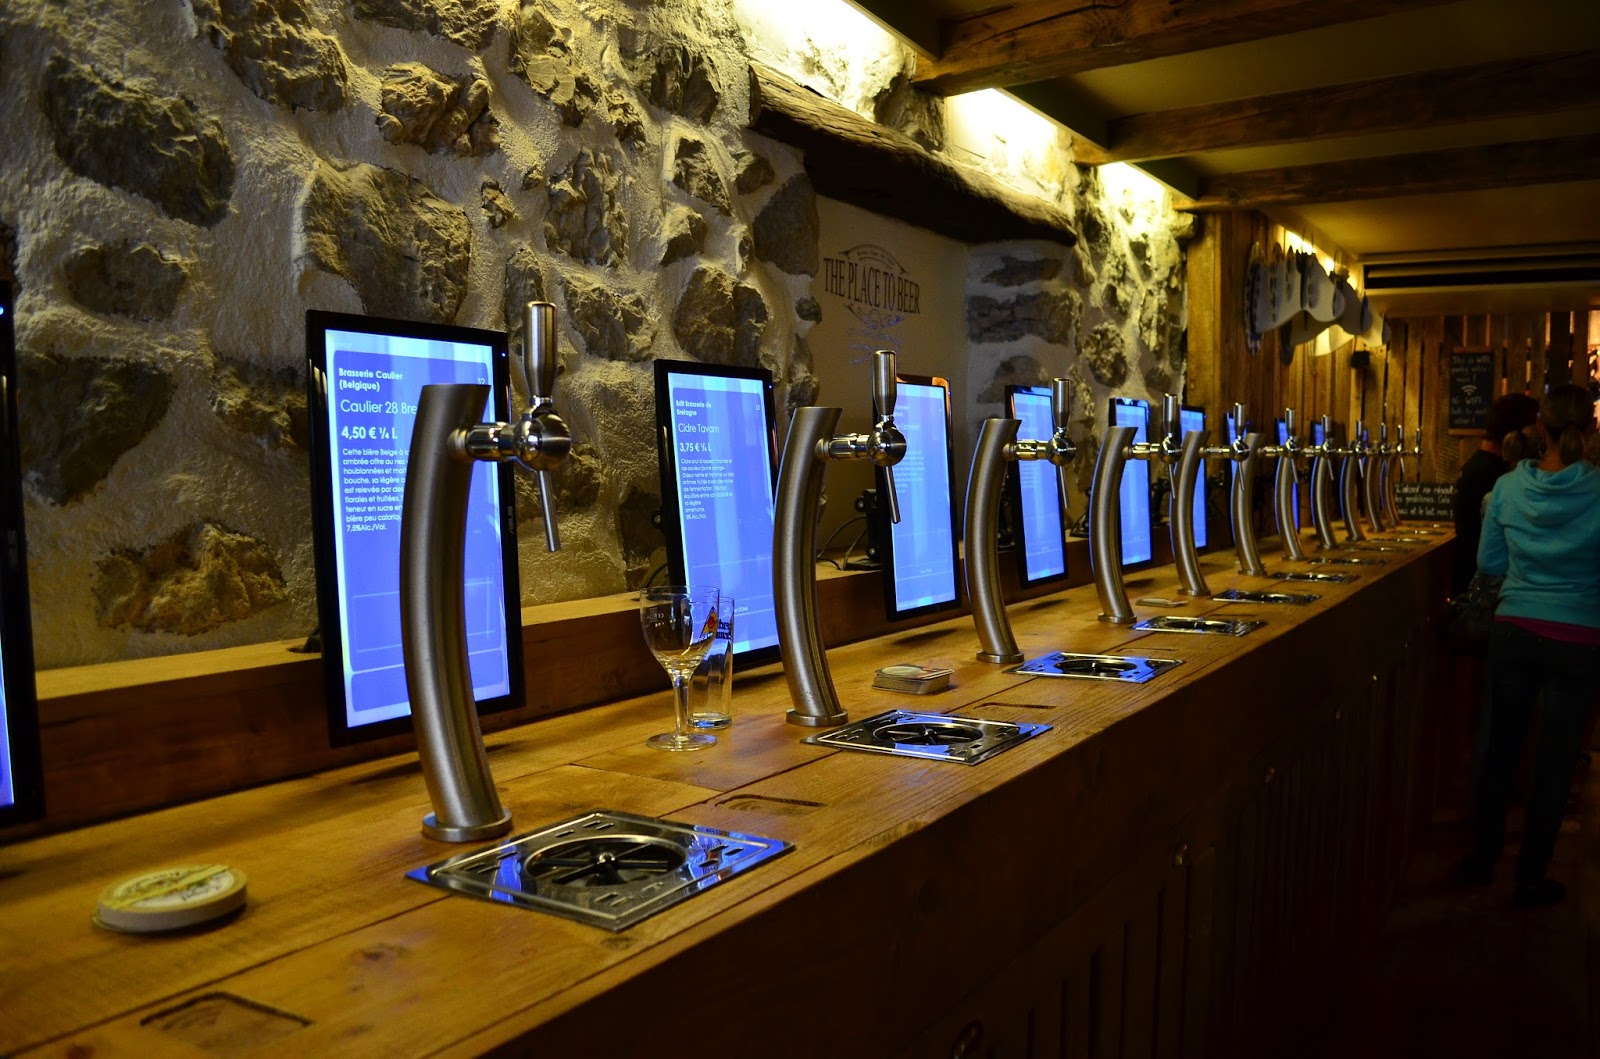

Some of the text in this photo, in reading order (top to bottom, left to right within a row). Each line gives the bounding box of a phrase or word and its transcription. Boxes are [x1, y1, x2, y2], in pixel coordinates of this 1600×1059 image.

[824, 258, 846, 297] THE
[848, 261, 880, 308] PLACE
[882, 271, 896, 311] TO
[897, 276, 920, 314] BEER
[339, 368, 403, 380] Brasserie Caulier
[339, 379, 380, 392] (Belgique)
[340, 399, 383, 413] Caulier
[385, 401, 398, 414] 28
[677, 409, 697, 417] Bretagne
[341, 426, 366, 440] 4,50
[369, 427, 377, 439] €
[678, 423, 696, 432] Cidre
[680, 442, 694, 452] 3,75
[695, 443, 700, 452] €
